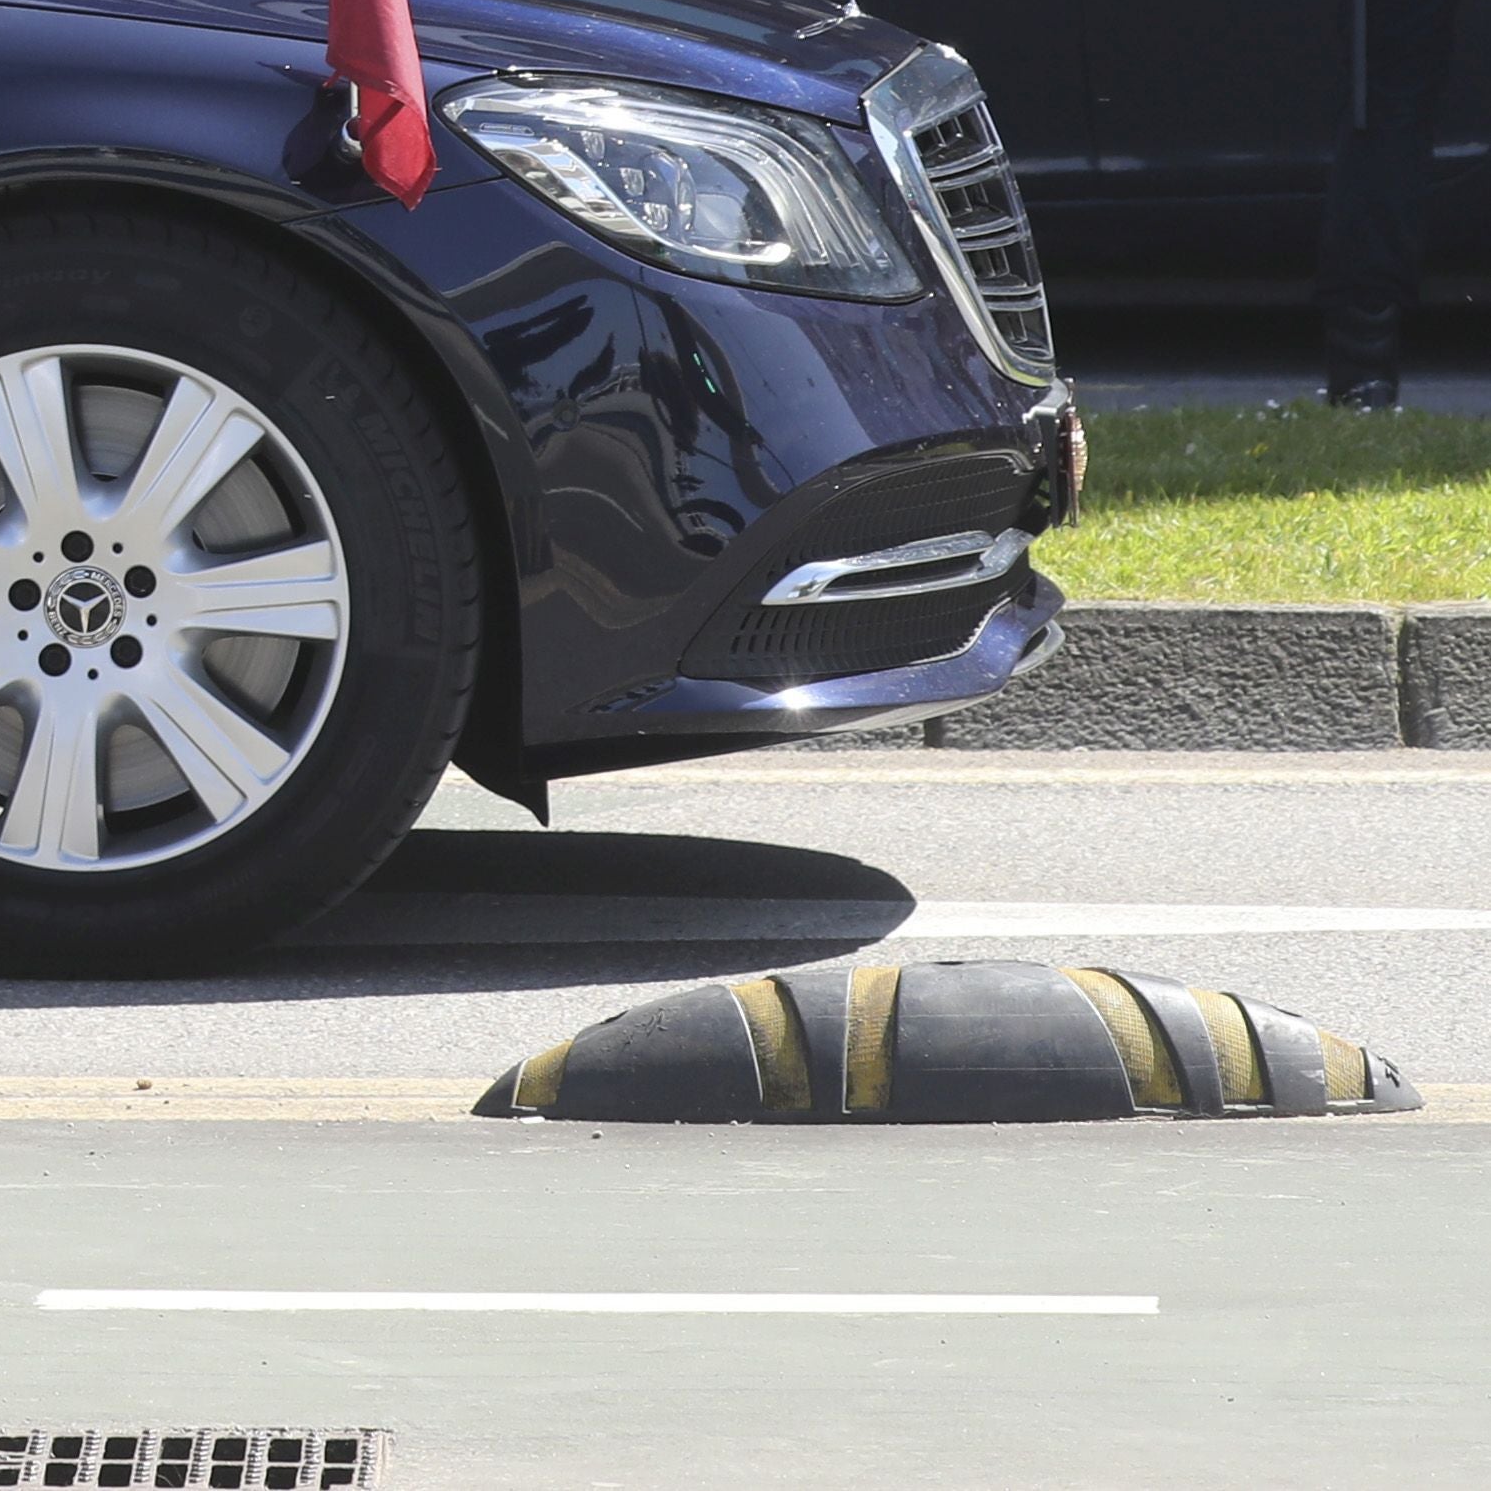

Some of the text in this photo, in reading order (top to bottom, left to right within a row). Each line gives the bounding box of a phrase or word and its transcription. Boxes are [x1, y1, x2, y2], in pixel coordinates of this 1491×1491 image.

[355, 410, 441, 642] MICHELIN
[48, 572, 123, 635] MERCEDES BENZ
